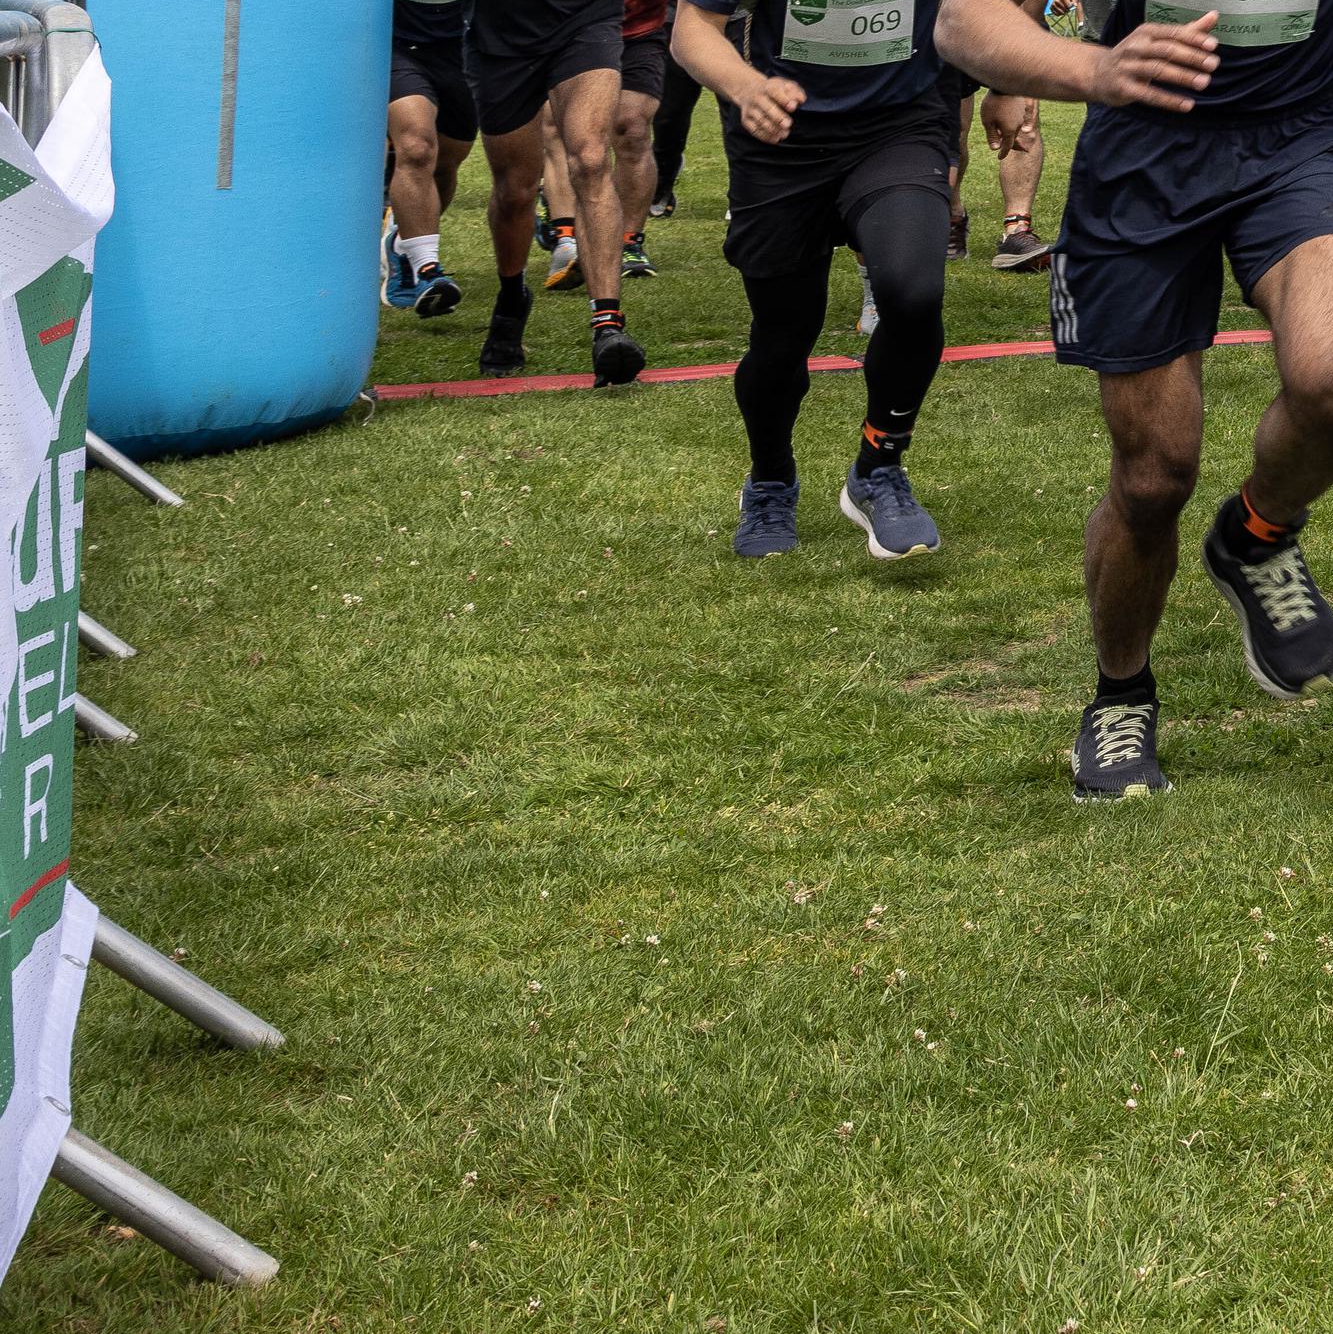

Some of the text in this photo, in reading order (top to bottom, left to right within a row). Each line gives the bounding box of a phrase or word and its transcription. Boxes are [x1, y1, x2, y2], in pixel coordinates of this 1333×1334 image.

[850, 9, 901, 36] 069
[1211, 24, 1261, 35] ARAYAN
[828, 50, 869, 59] AVISHEK
